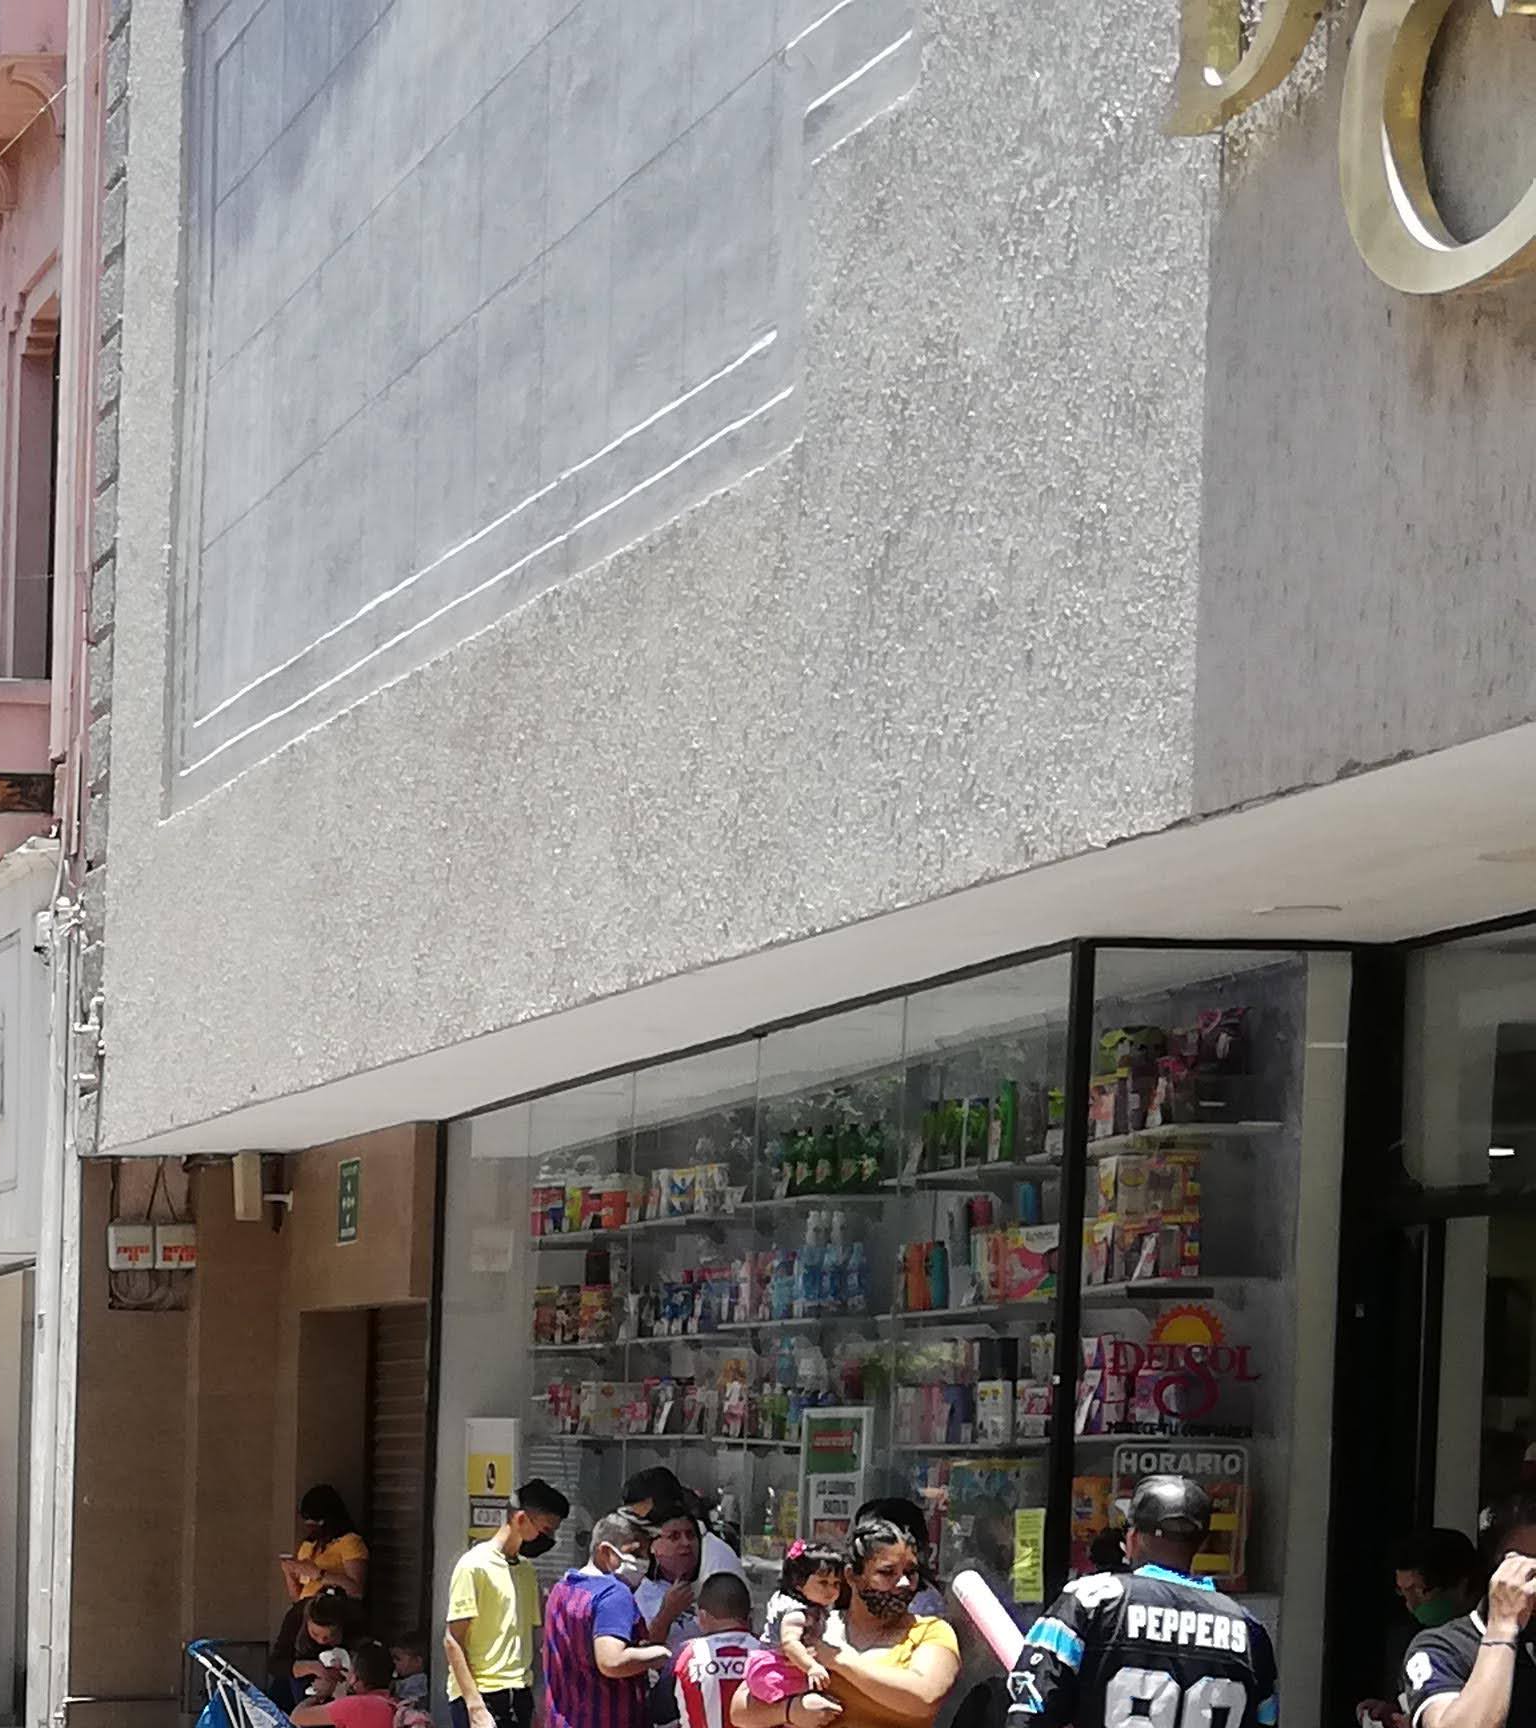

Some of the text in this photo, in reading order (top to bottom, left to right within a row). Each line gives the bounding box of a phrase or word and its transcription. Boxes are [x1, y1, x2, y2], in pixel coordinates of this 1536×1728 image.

[1120, 1452, 1241, 1476] HORARIO
[1128, 1604, 1247, 1653] PEPPERS
[694, 1661, 745, 1676] TOYO
